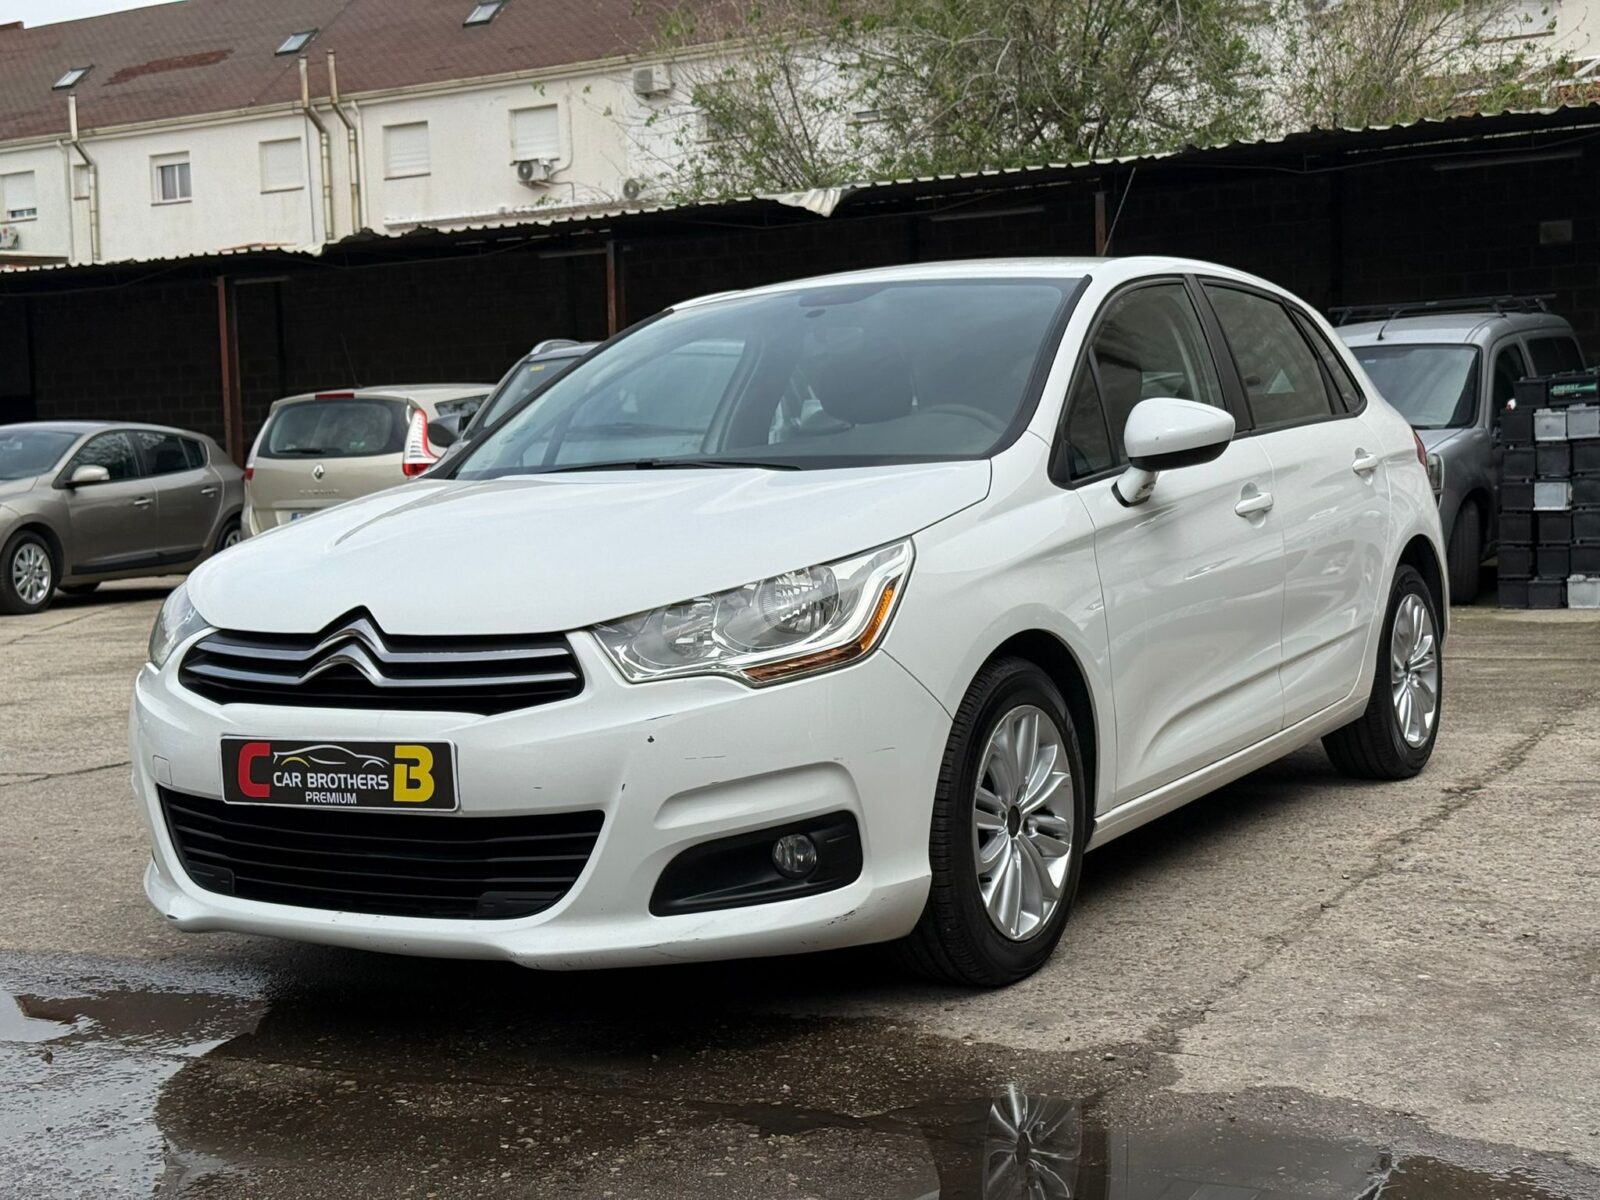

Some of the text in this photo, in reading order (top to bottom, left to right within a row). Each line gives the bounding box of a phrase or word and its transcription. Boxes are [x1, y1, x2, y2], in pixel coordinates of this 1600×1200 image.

[237, 742, 271, 798] C
[273, 771, 389, 790] CAR BROTHERS
[305, 791, 357, 804] PREMIUM
